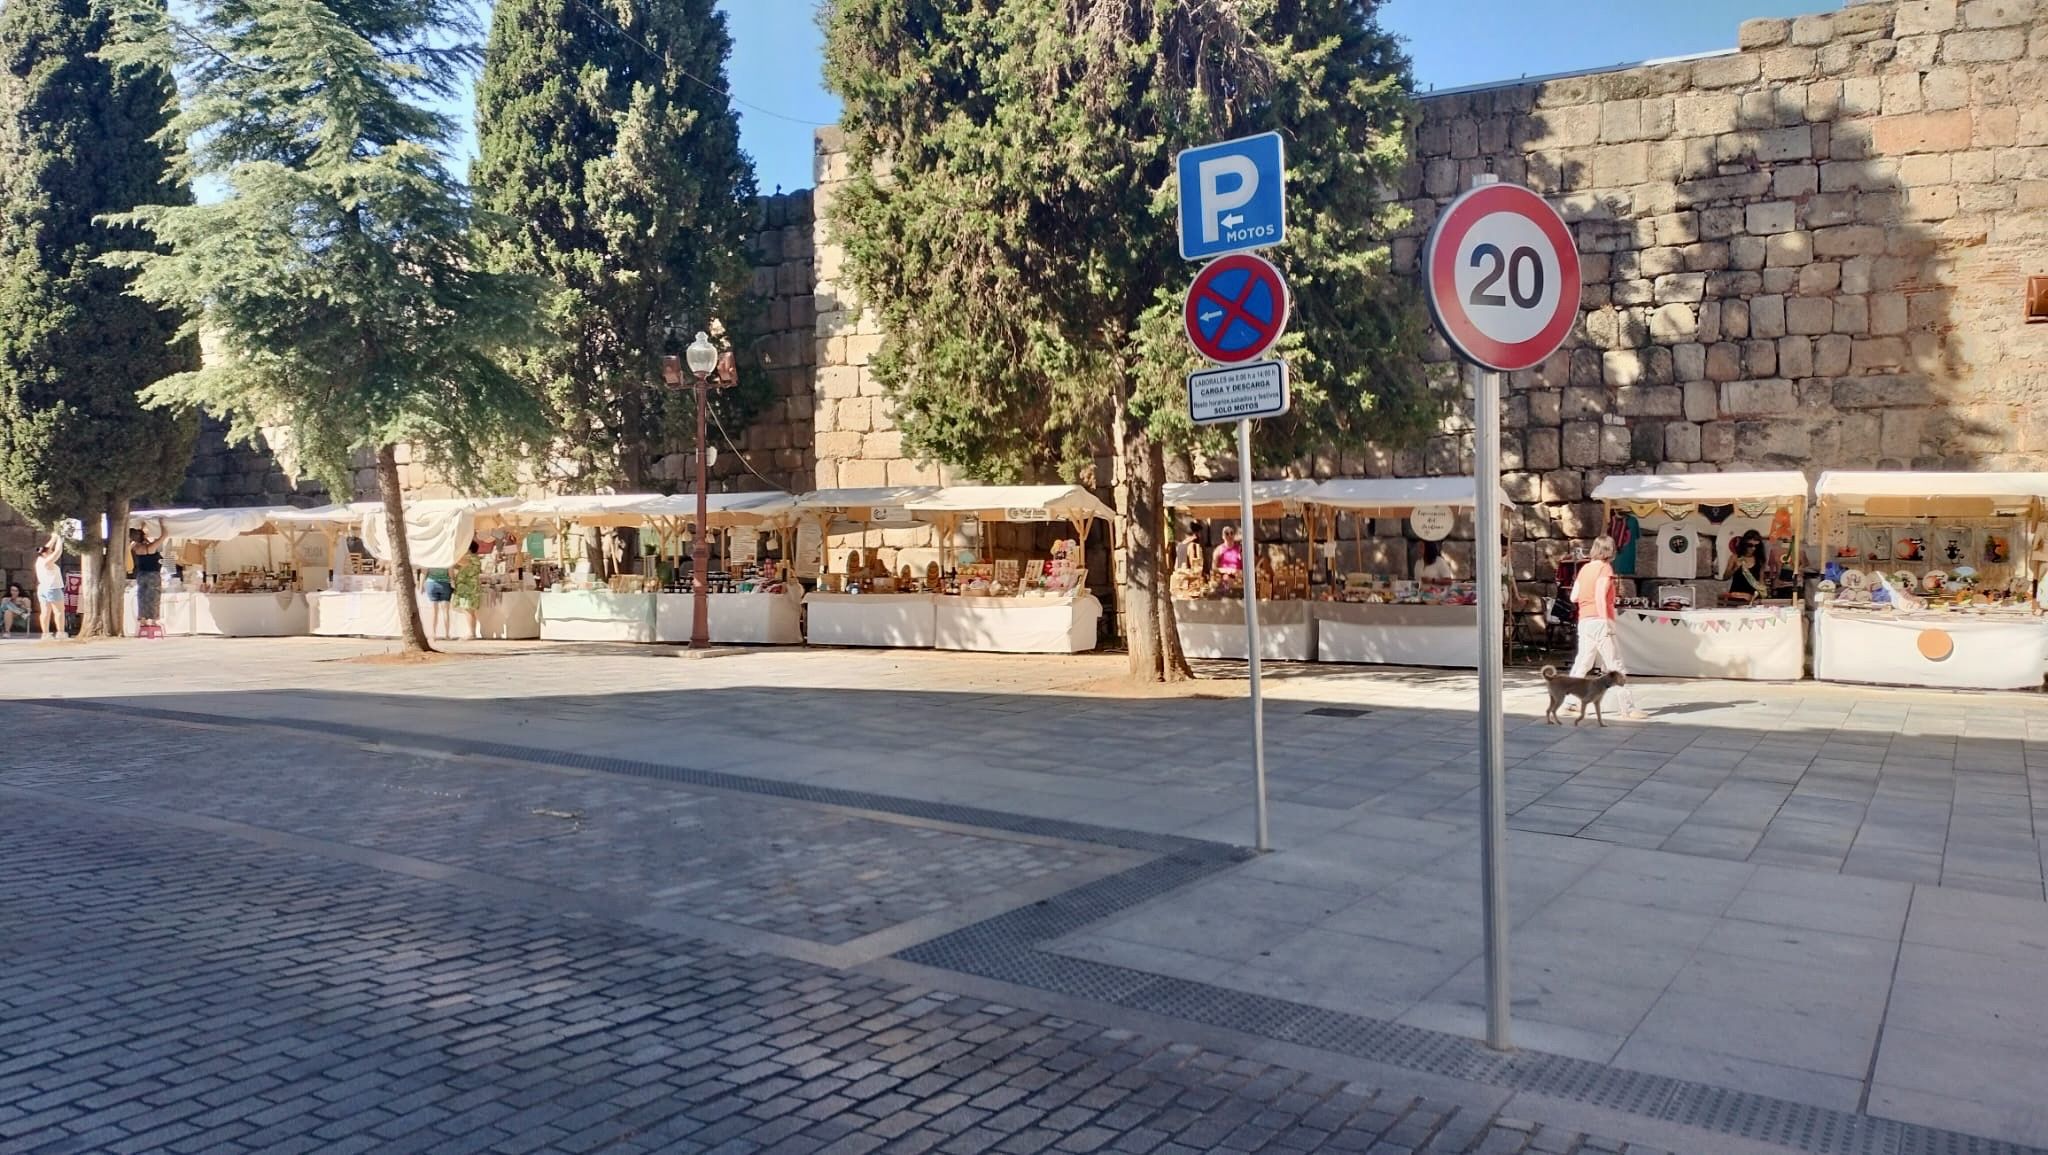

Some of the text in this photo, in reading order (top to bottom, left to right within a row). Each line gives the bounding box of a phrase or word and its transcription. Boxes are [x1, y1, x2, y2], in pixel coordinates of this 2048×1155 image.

[1199, 154, 1260, 243] P
[1226, 224, 1275, 243] MOTOS
[1469, 243, 1544, 309] 20
[1195, 376, 1227, 387] LABORALES
[1200, 380, 1270, 396] CARGA Y DESCARGA
[1214, 402, 1259, 415] SOLO MOTOS
